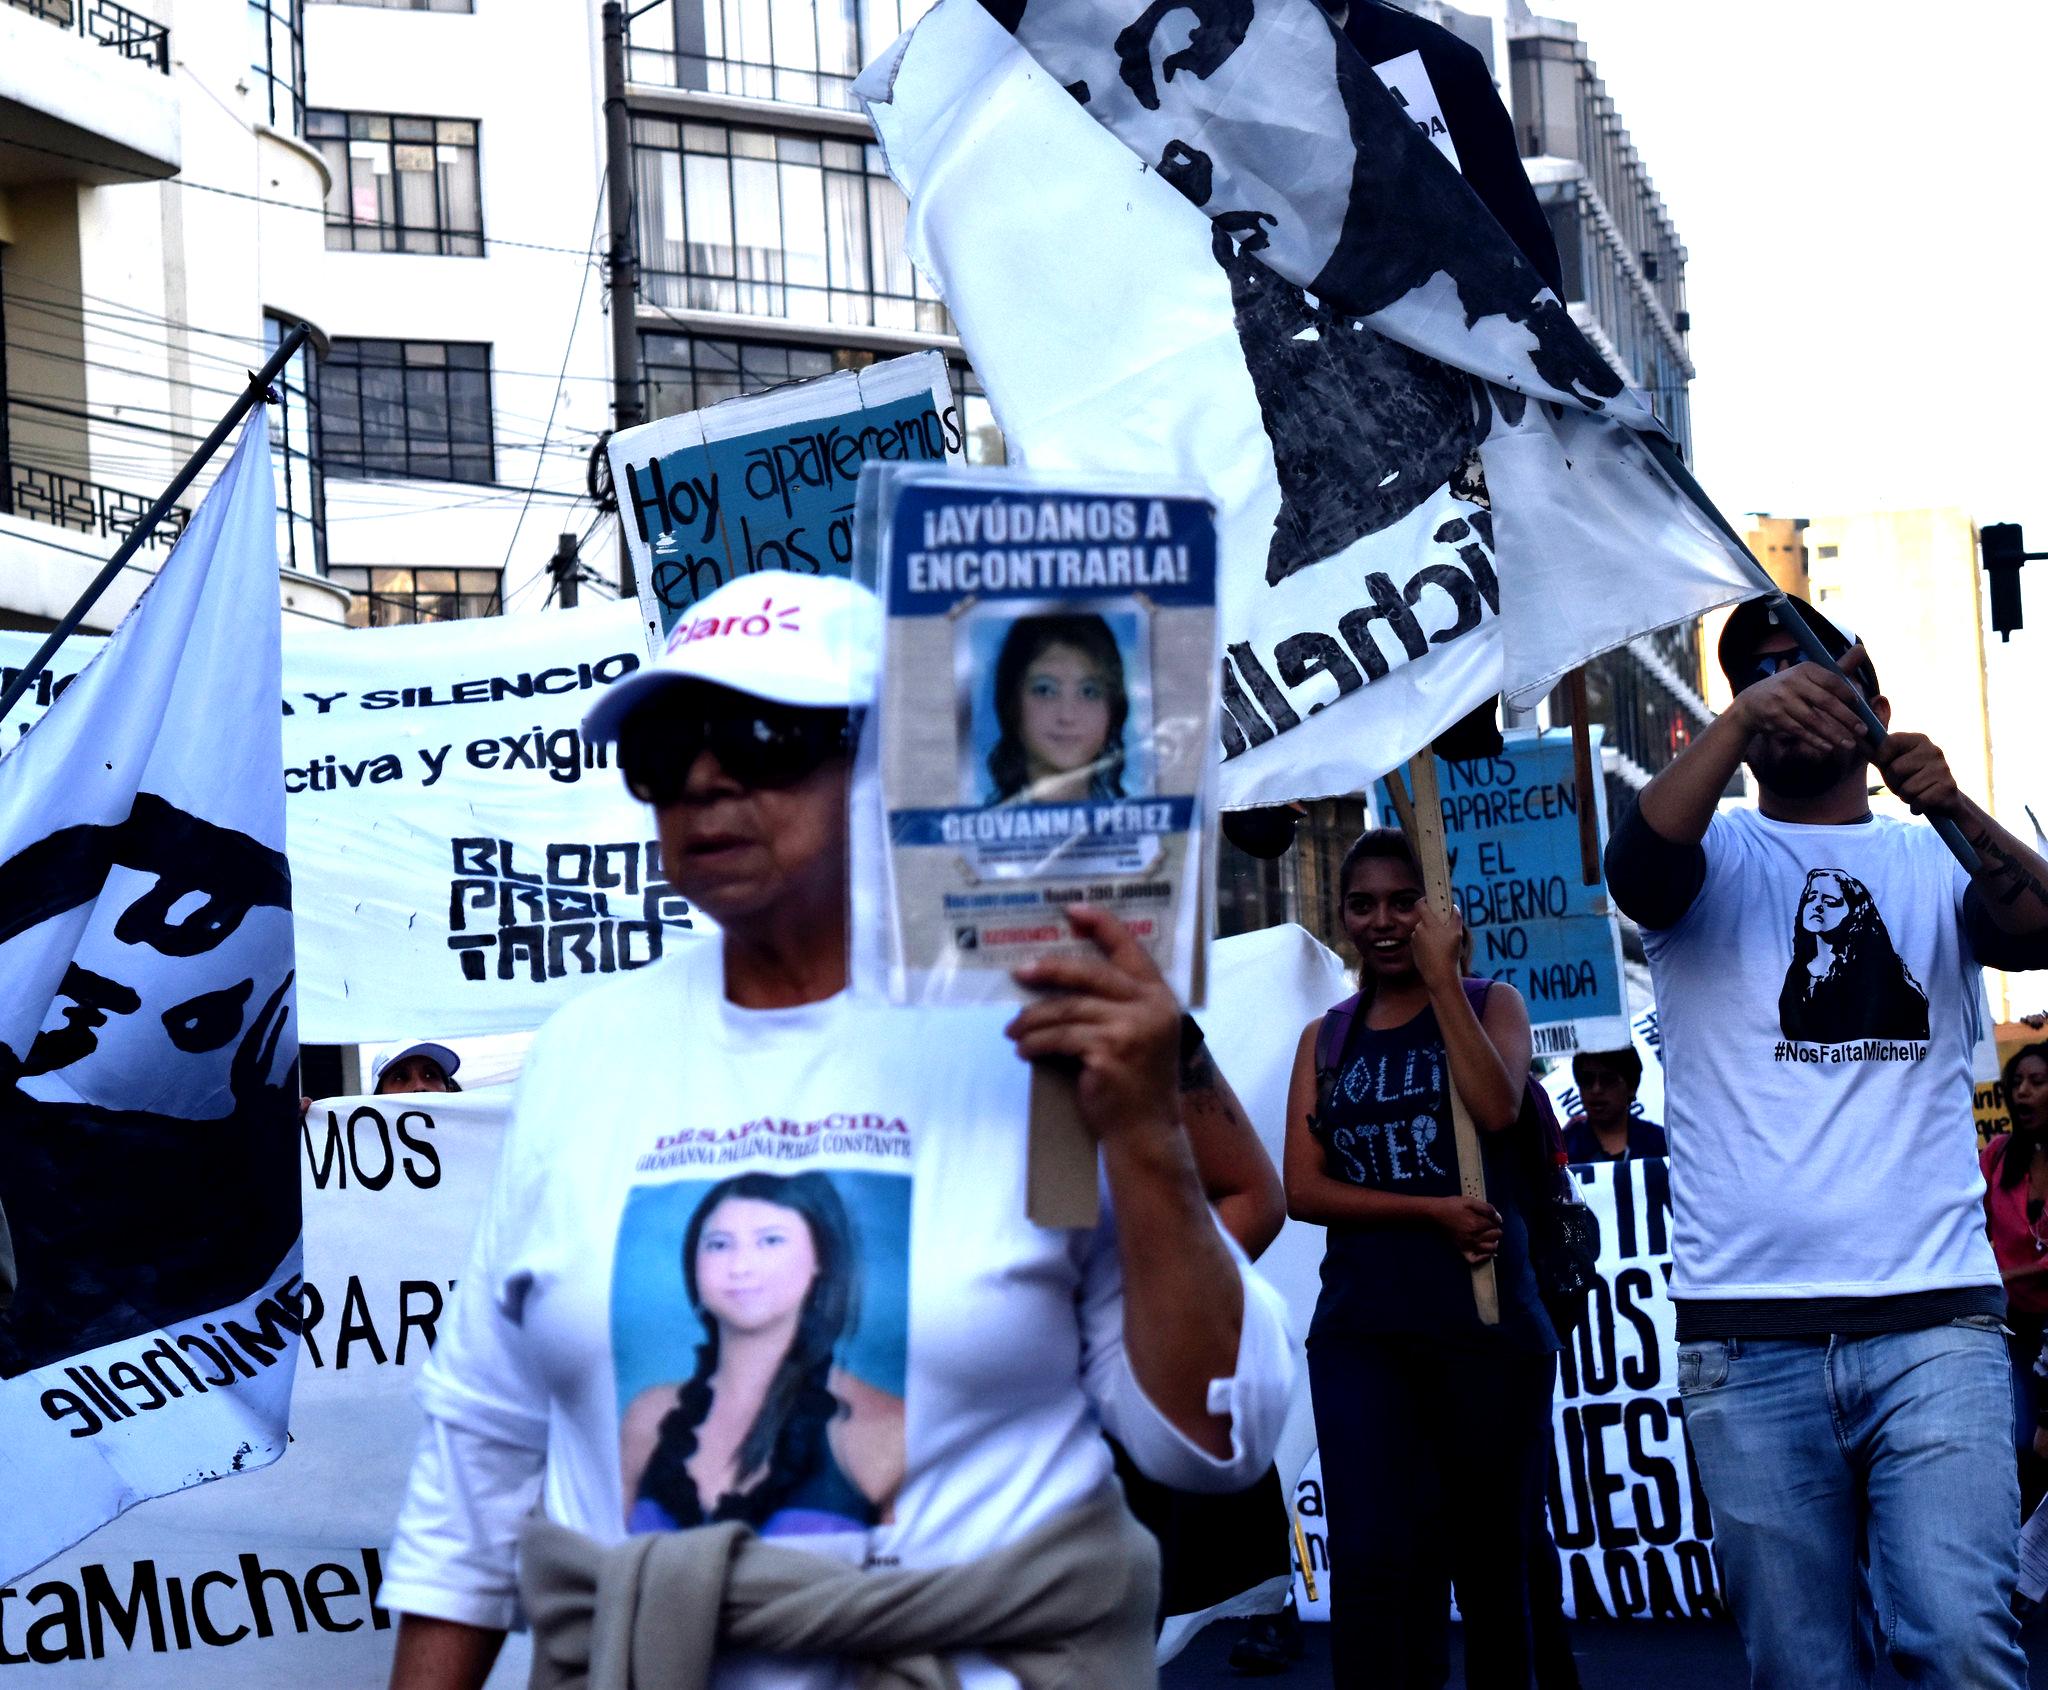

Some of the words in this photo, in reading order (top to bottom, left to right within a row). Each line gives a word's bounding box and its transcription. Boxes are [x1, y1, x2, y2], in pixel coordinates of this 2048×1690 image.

[625, 457, 718, 544] Hoy
[923, 496, 1137, 549] ¡AYÚDANOS
[1145, 500, 1171, 540] A
[651, 553, 723, 614] en
[740, 516, 821, 575] los
[907, 546, 1188, 592] ENCONTRARLA!
[303, 692, 347, 713] Y
[360, 652, 640, 709] SILENCIO
[418, 744, 452, 786] y
[1449, 757, 1516, 791] NOS
[1479, 842, 1516, 876] EL
[447, 921, 663, 983] TARIO
[1486, 926, 1528, 961] NO
[1529, 959, 1598, 1001] NADA
[1774, 1041, 1928, 1064] #NosFaltaMichelle
[654, 1112, 910, 1152] DESAPARECIDA
